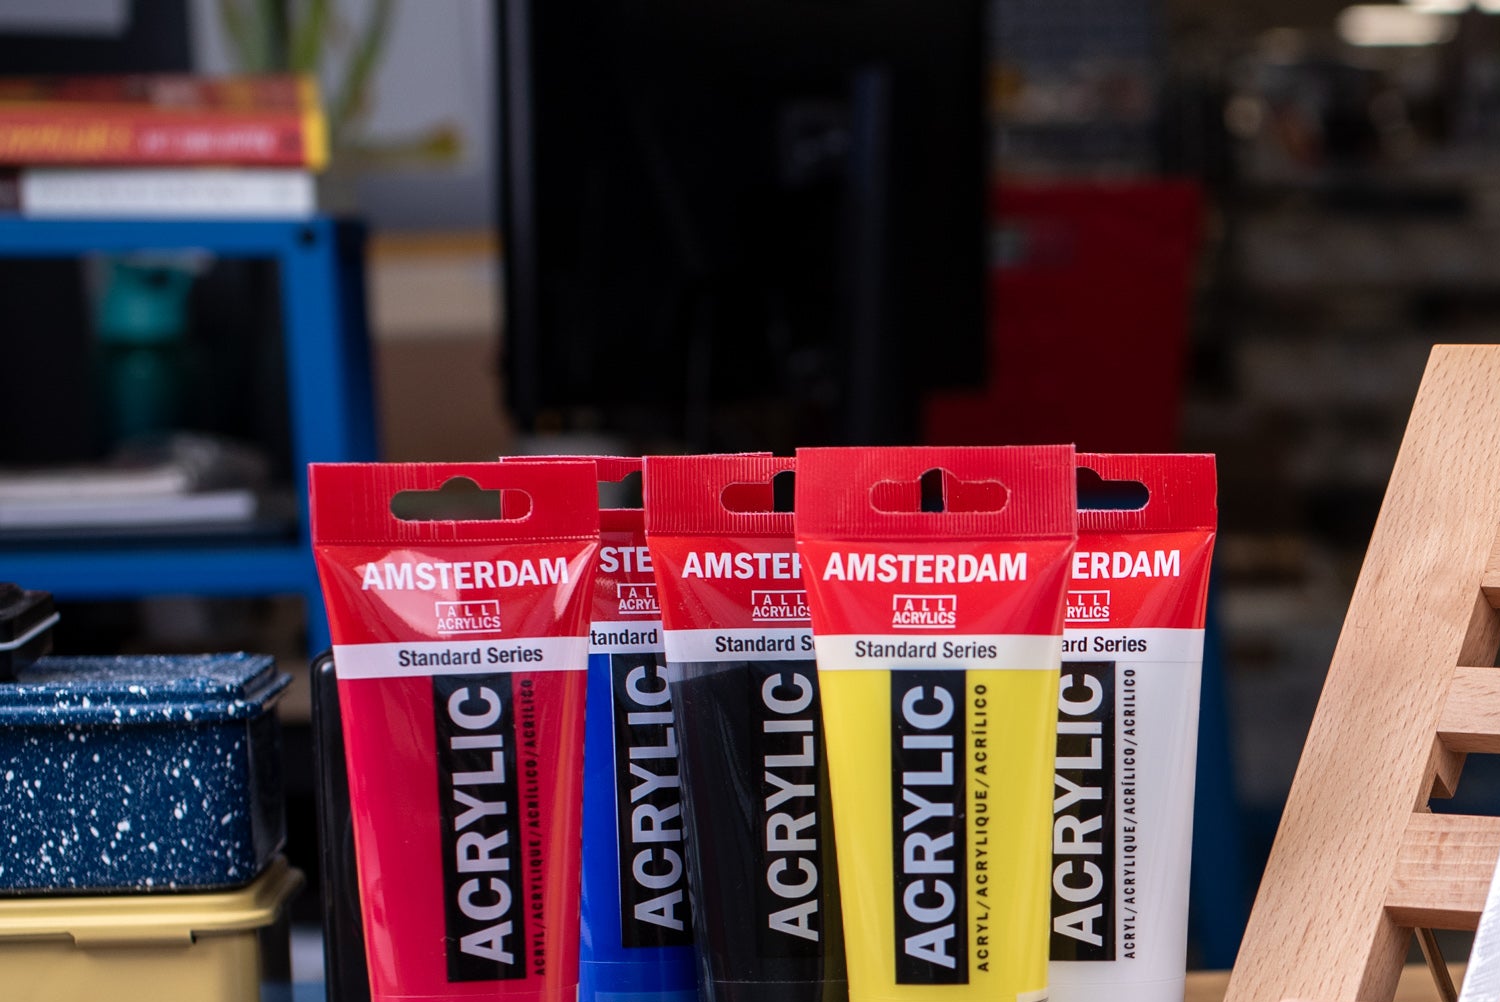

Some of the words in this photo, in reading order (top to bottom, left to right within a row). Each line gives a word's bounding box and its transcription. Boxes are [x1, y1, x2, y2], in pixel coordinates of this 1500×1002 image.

[361, 557, 569, 591] AMSTERDAM
[681, 552, 802, 579] AMSTE
[823, 552, 1027, 583] AMSTERDAM
[1071, 549, 1180, 579] ERDAM
[619, 599, 660, 610] ACRYL
[1066, 606, 1110, 618] RYLICS
[437, 615, 501, 630] ACRYLICS
[892, 612, 956, 624] ACRYLICS
[590, 628, 658, 645] tandard
[715, 636, 795, 652] Standard
[1093, 636, 1147, 652] Series
[398, 648, 481, 667] Standard
[487, 646, 543, 663] Series
[855, 640, 936, 658] Standard
[943, 642, 997, 659] Series
[625, 665, 684, 931] ACRYLIC
[762, 672, 818, 941] ACRYLIC
[1052, 673, 1103, 947] ACRYLIC
[448, 686, 514, 965] ACRYLIC
[902, 685, 956, 969] ACRYLIC
